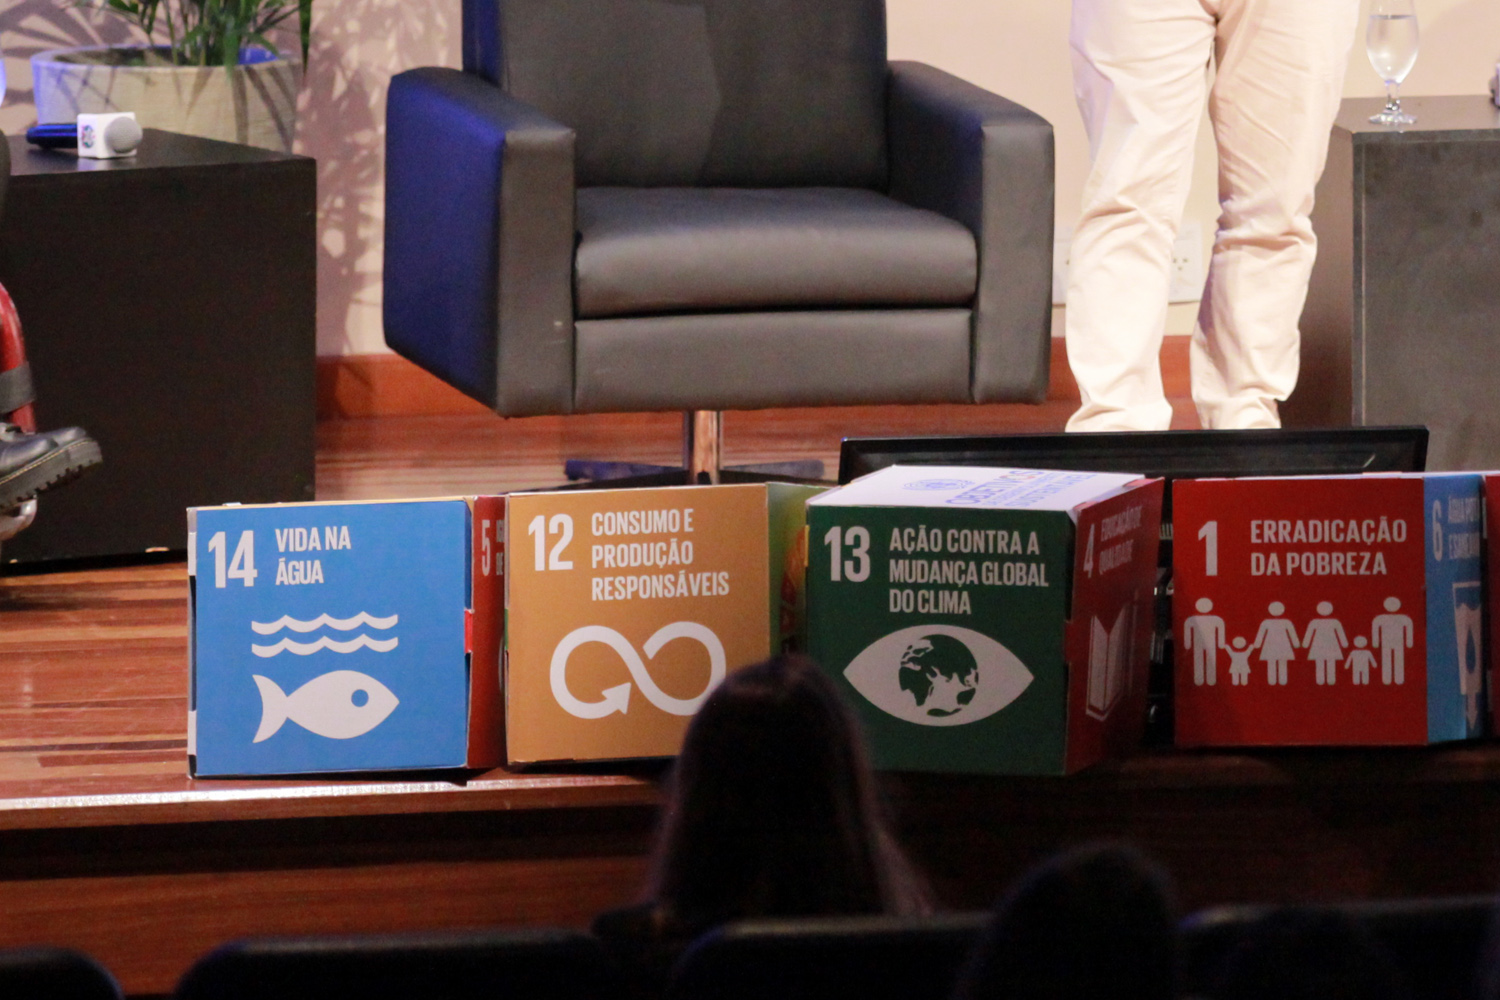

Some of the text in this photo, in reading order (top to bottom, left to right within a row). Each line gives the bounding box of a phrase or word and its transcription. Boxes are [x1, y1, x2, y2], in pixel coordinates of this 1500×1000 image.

[591, 508, 694, 537] CONSUMO E
[1250, 518, 1407, 546] ERRADICAÇÃO
[1432, 499, 1443, 561] 6
[274, 525, 352, 553] VIDA NA
[482, 519, 491, 576] 5
[528, 513, 574, 572] 12
[591, 537, 693, 569] PRODUÇÃO
[824, 525, 871, 583] 13
[889, 524, 1040, 555] AÇÃO CONTRA A
[1083, 523, 1095, 579] 4
[1197, 520, 1218, 577] 1
[207, 529, 259, 589] 14
[275, 556, 325, 586] ÁGUA
[889, 558, 1049, 588] MUDANÇA GLOBAL
[1250, 550, 1388, 577] DA POBREZA
[591, 569, 730, 602] RESPONSÁVEIS
[889, 588, 972, 615] DO CLIMA
